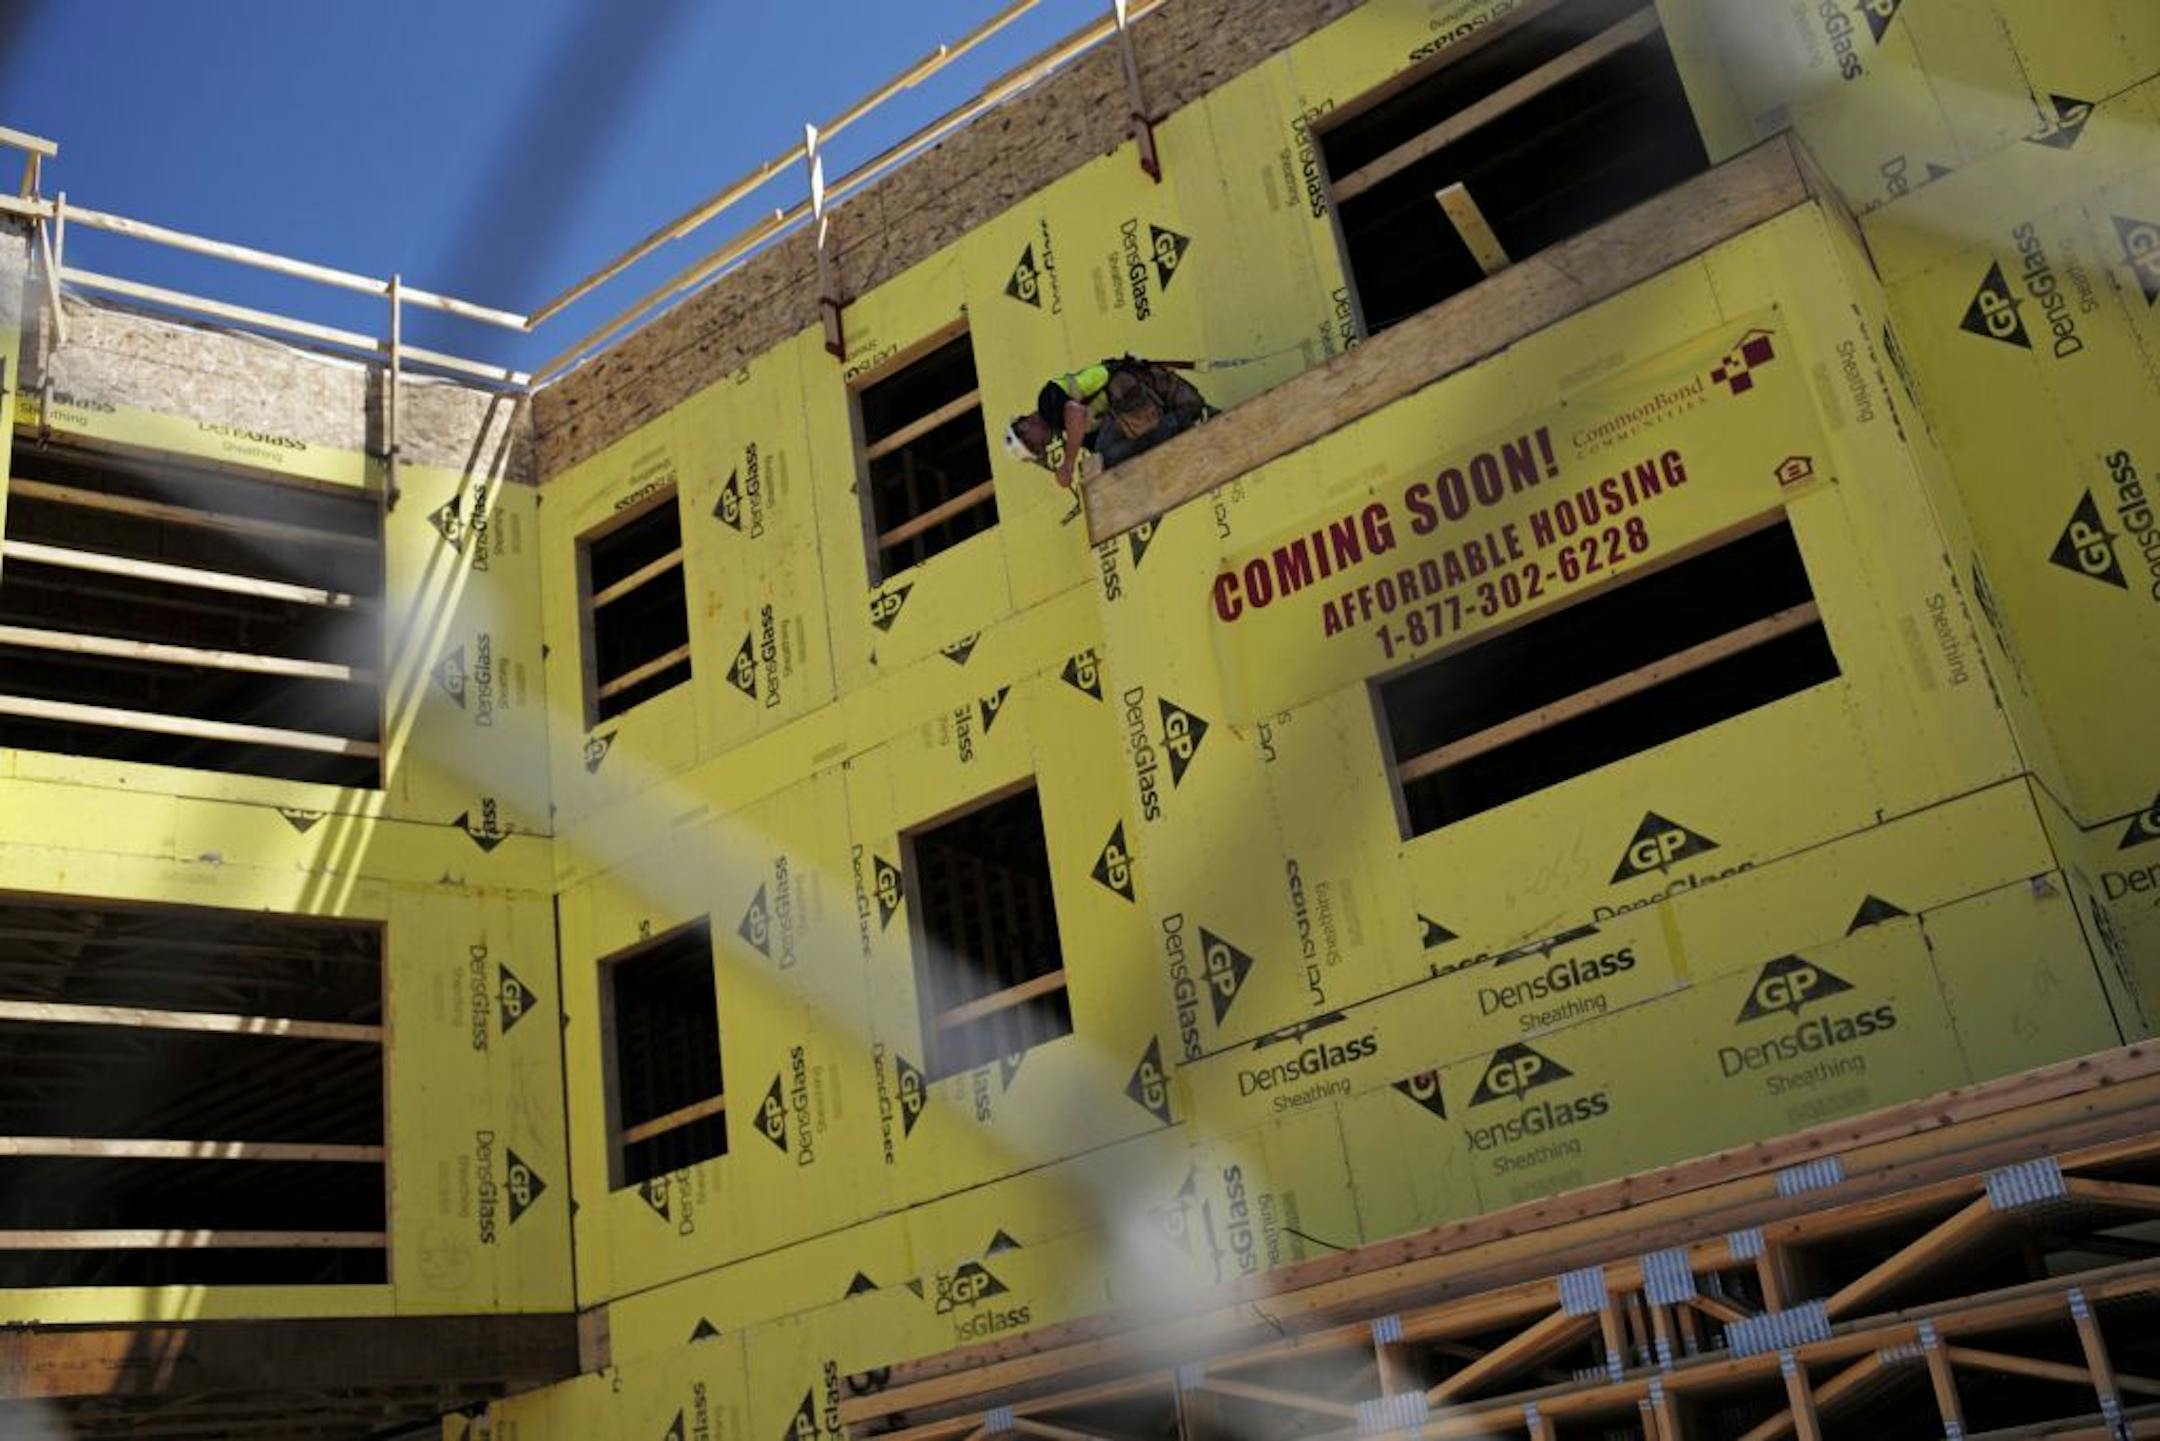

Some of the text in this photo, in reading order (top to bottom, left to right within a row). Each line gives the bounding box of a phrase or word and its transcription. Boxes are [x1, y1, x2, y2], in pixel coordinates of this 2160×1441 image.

[1120, 217, 1152, 322] DensGlass
[2012, 222, 2084, 360] DensGlass
[1572, 374, 1705, 449] CommonBond
[471, 484, 490, 573] DensGlass
[745, 441, 765, 540] DensGlass
[1213, 426, 1559, 624] COMING SOON!
[1322, 449, 1688, 639] AFFORDABLE HOUSING
[1375, 515, 1650, 660] 1-877-302-6228
[472, 632, 493, 727] DensGlass
[760, 603, 781, 710] DensGlass
[1925, 593, 1970, 686] Sheathing
[1123, 685, 1161, 822] DensGlass
[1629, 830, 1688, 871] GP
[770, 855, 797, 971] DensGlass
[469, 944, 491, 1052] DensGlass
[1161, 911, 1202, 1063] DensGlass
[1478, 946, 1636, 1017] DensGlass
[1519, 993, 1607, 1033] Sheathing
[1756, 967, 1820, 1009] GP
[1238, 1033, 1378, 1097] DensGlass
[1486, 1055, 1542, 1095] GP
[1718, 1004, 1897, 1079] DensGlass
[1765, 1053, 1867, 1096] Sheathing
[790, 1046, 815, 1168] DensGlass
[1273, 1078, 1351, 1113] Sheathing
[475, 1129, 498, 1245] DensGlass
[1493, 1138, 1582, 1177] Sheathing
[954, 1304, 1031, 1342] sGlass
